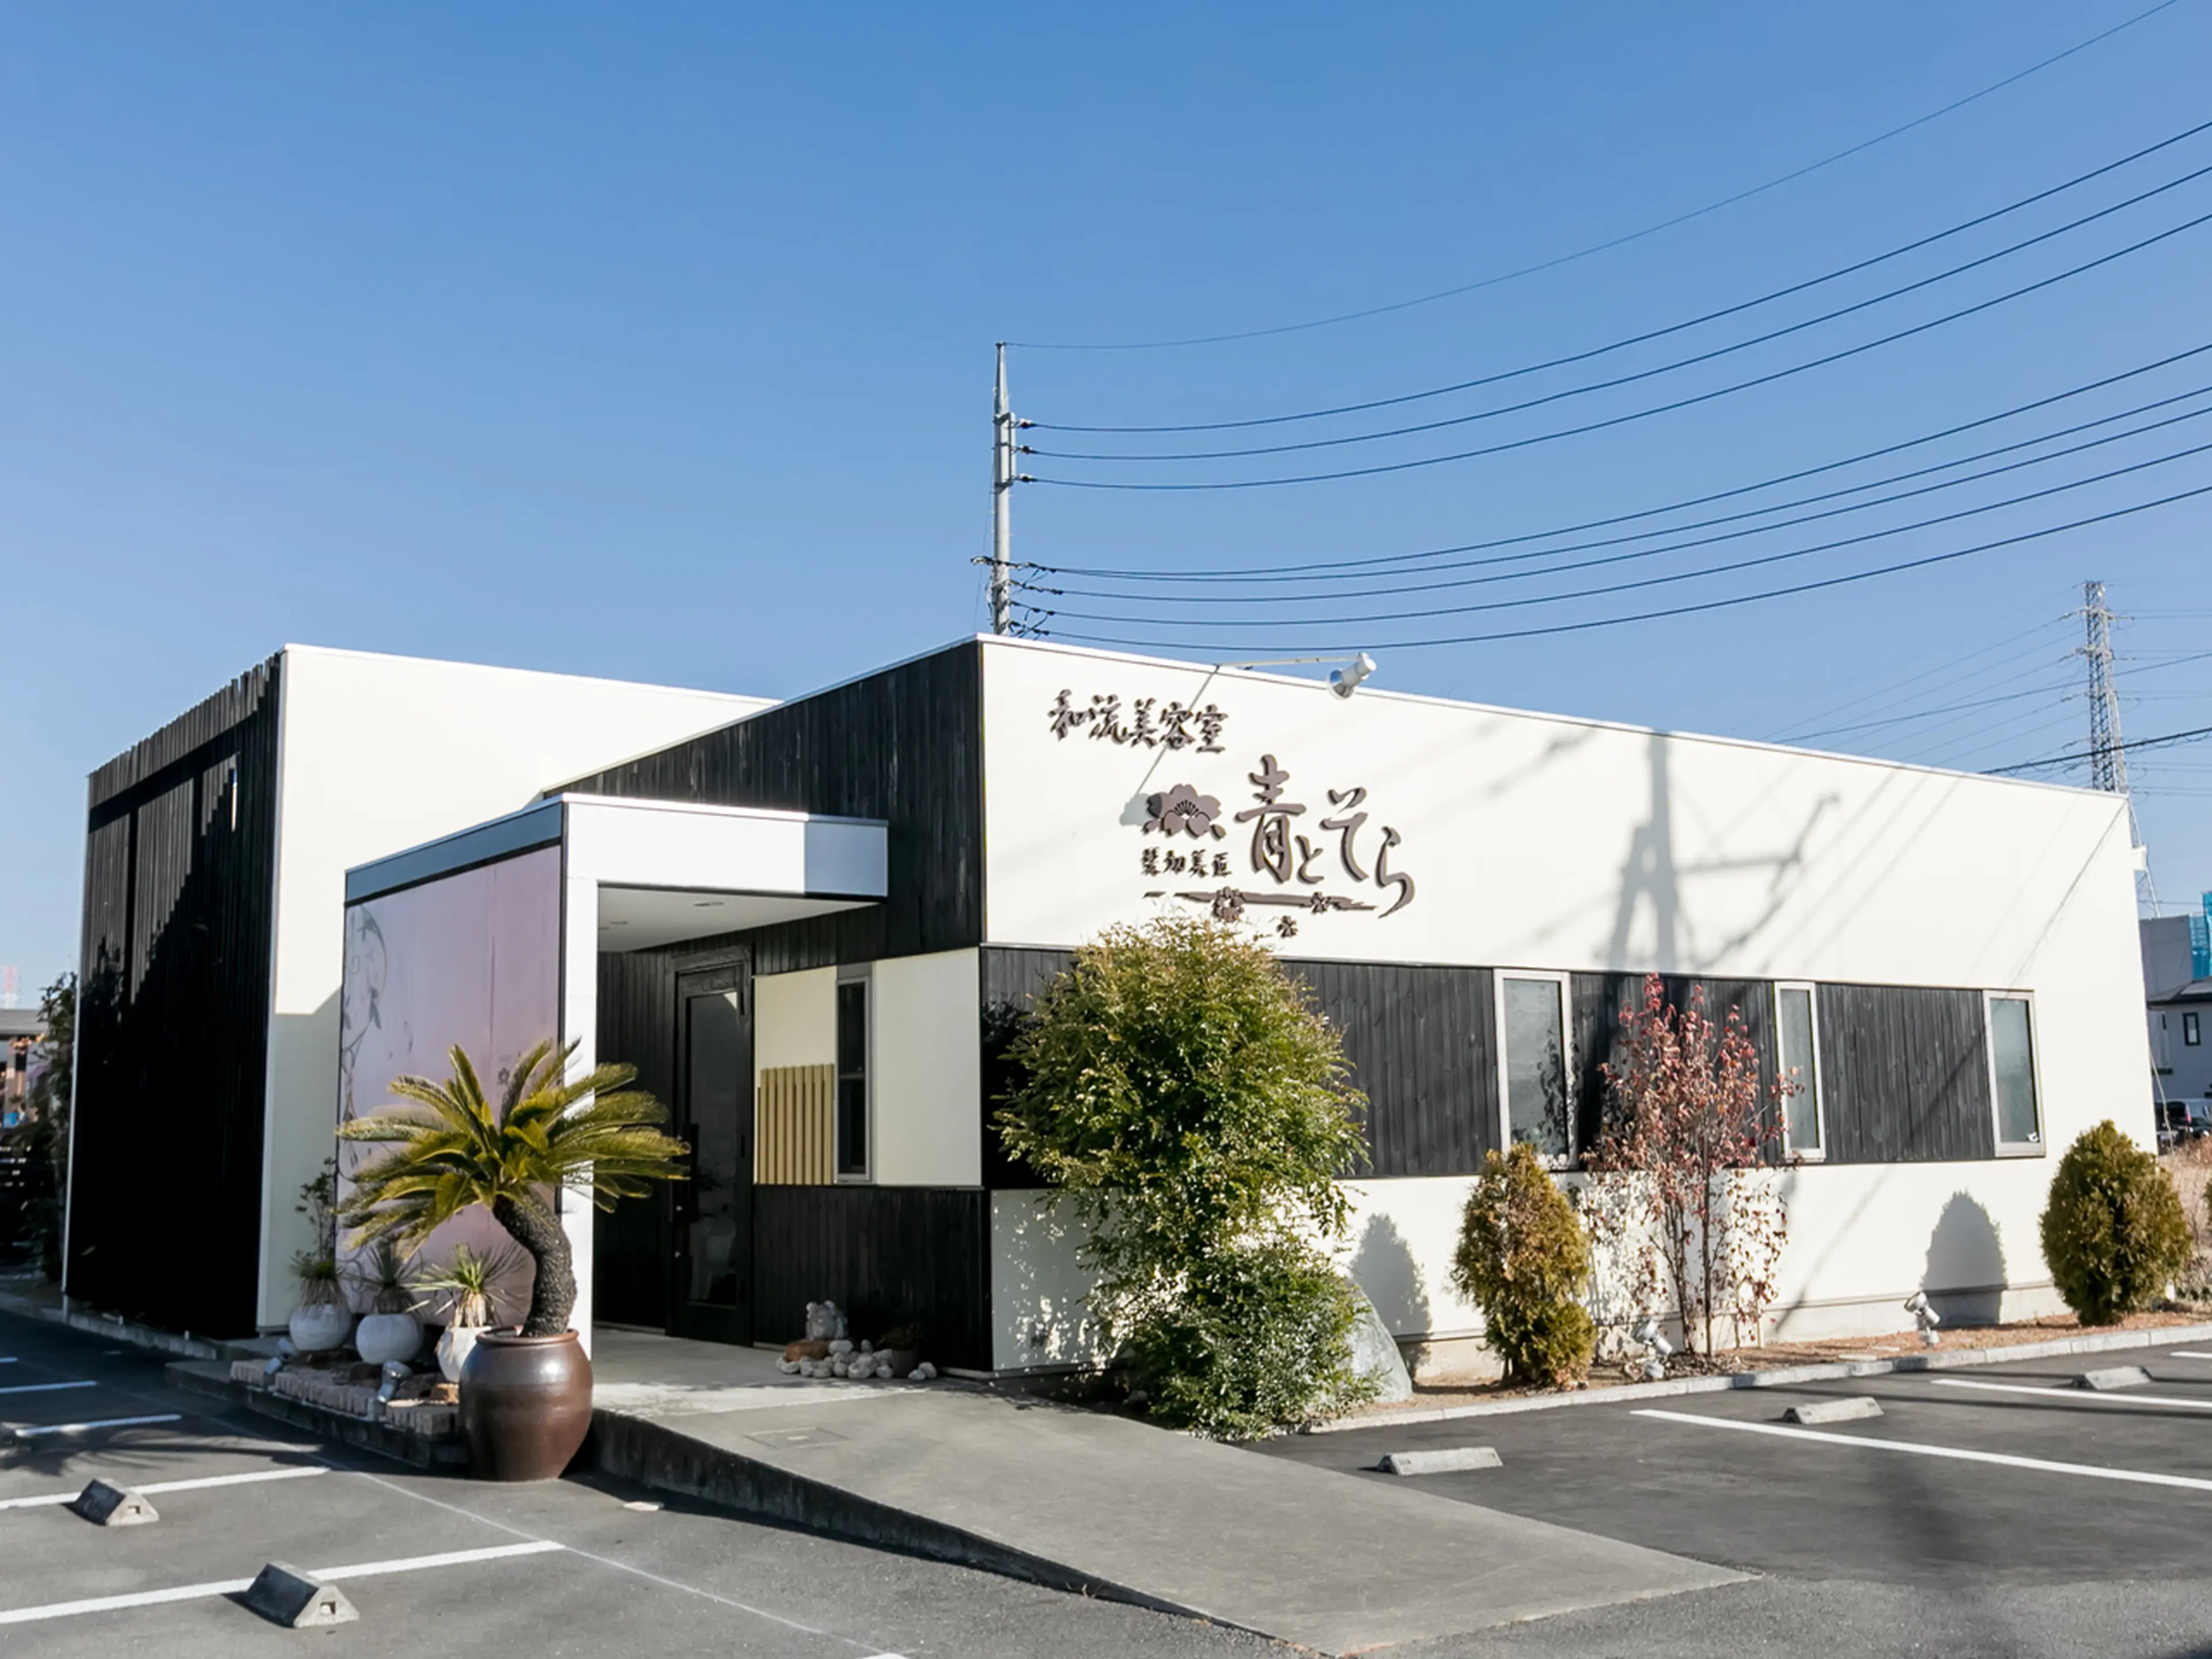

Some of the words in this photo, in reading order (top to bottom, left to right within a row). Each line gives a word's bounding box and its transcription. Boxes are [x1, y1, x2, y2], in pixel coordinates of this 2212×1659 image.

[1048, 689, 1228, 753] 和流美容室
[1233, 753, 1415, 919] 青とそら
